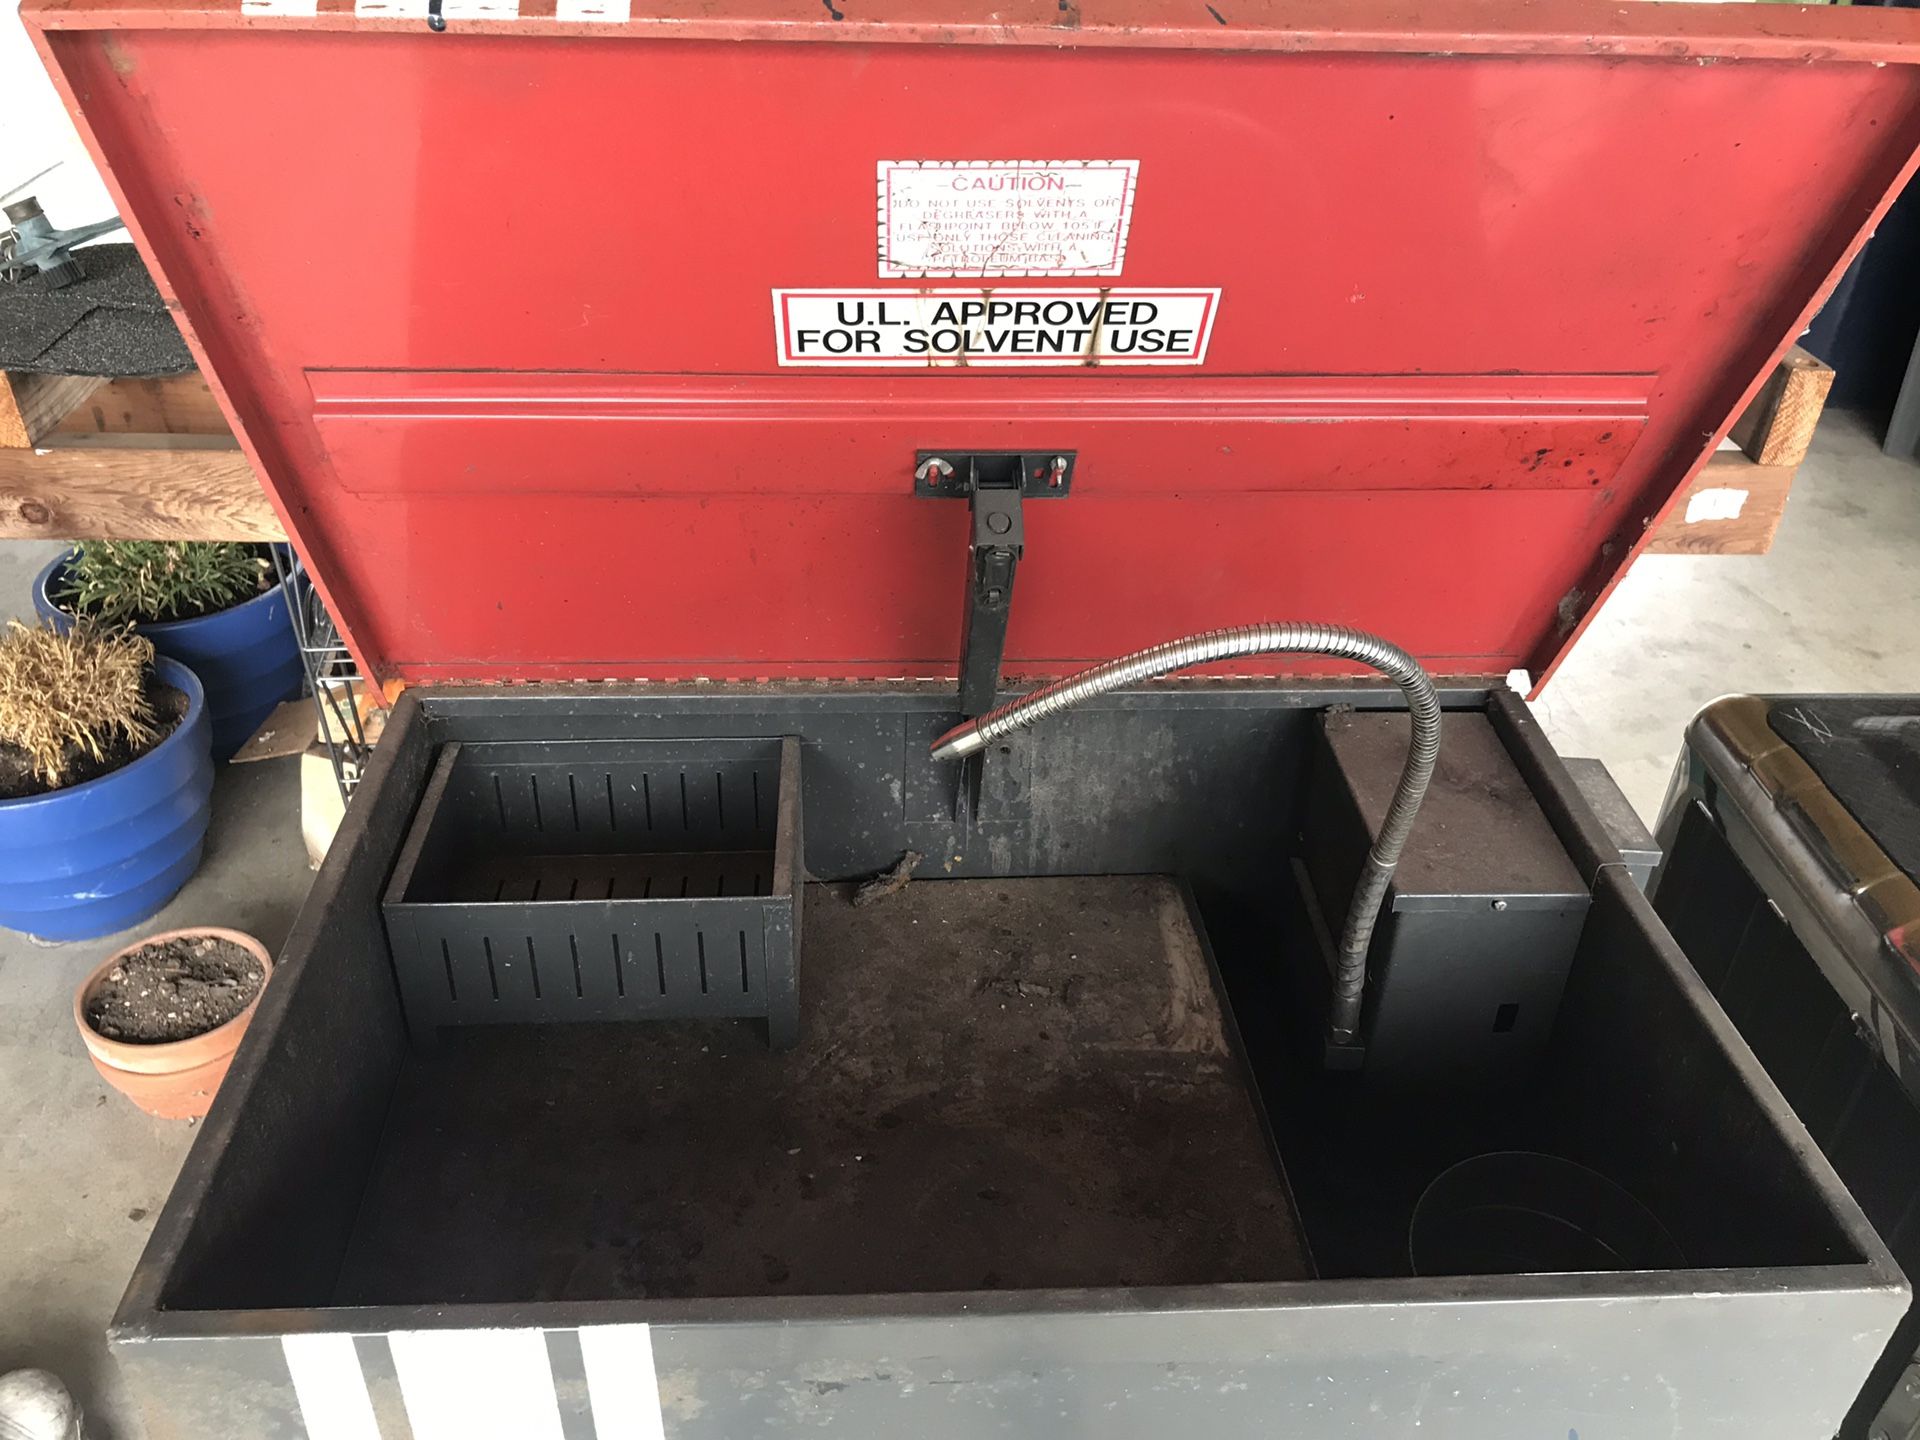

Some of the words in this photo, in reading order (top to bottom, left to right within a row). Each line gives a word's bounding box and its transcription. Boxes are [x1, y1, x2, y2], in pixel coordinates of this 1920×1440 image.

[951, 176, 1064, 192] CAUTION
[928, 199, 958, 208] NOT
[967, 199, 996, 208] USE
[1005, 198, 1086, 208] SOLVENTS
[1094, 198, 1117, 208] OR
[923, 210, 1025, 219] DEGREASERS
[1034, 210, 1071, 219] WITH
[1080, 210, 1088, 218] A
[899, 222, 992, 231] FLASHPOINT
[1001, 221, 1054, 230] BELOW
[1063, 221, 1090, 230] 105
[896, 233, 921, 242] USE
[933, 233, 970, 242] ONLY
[980, 231, 1028, 242] THOSE
[1024, 242, 1061, 251] WITH
[1069, 242, 1077, 251] A
[836, 302, 911, 326] U.L.
[930, 301, 1159, 326] APPROVED
[797, 330, 880, 353] FOR
[902, 330, 1091, 353] SOLVENT
[1110, 330, 1193, 353] USE
